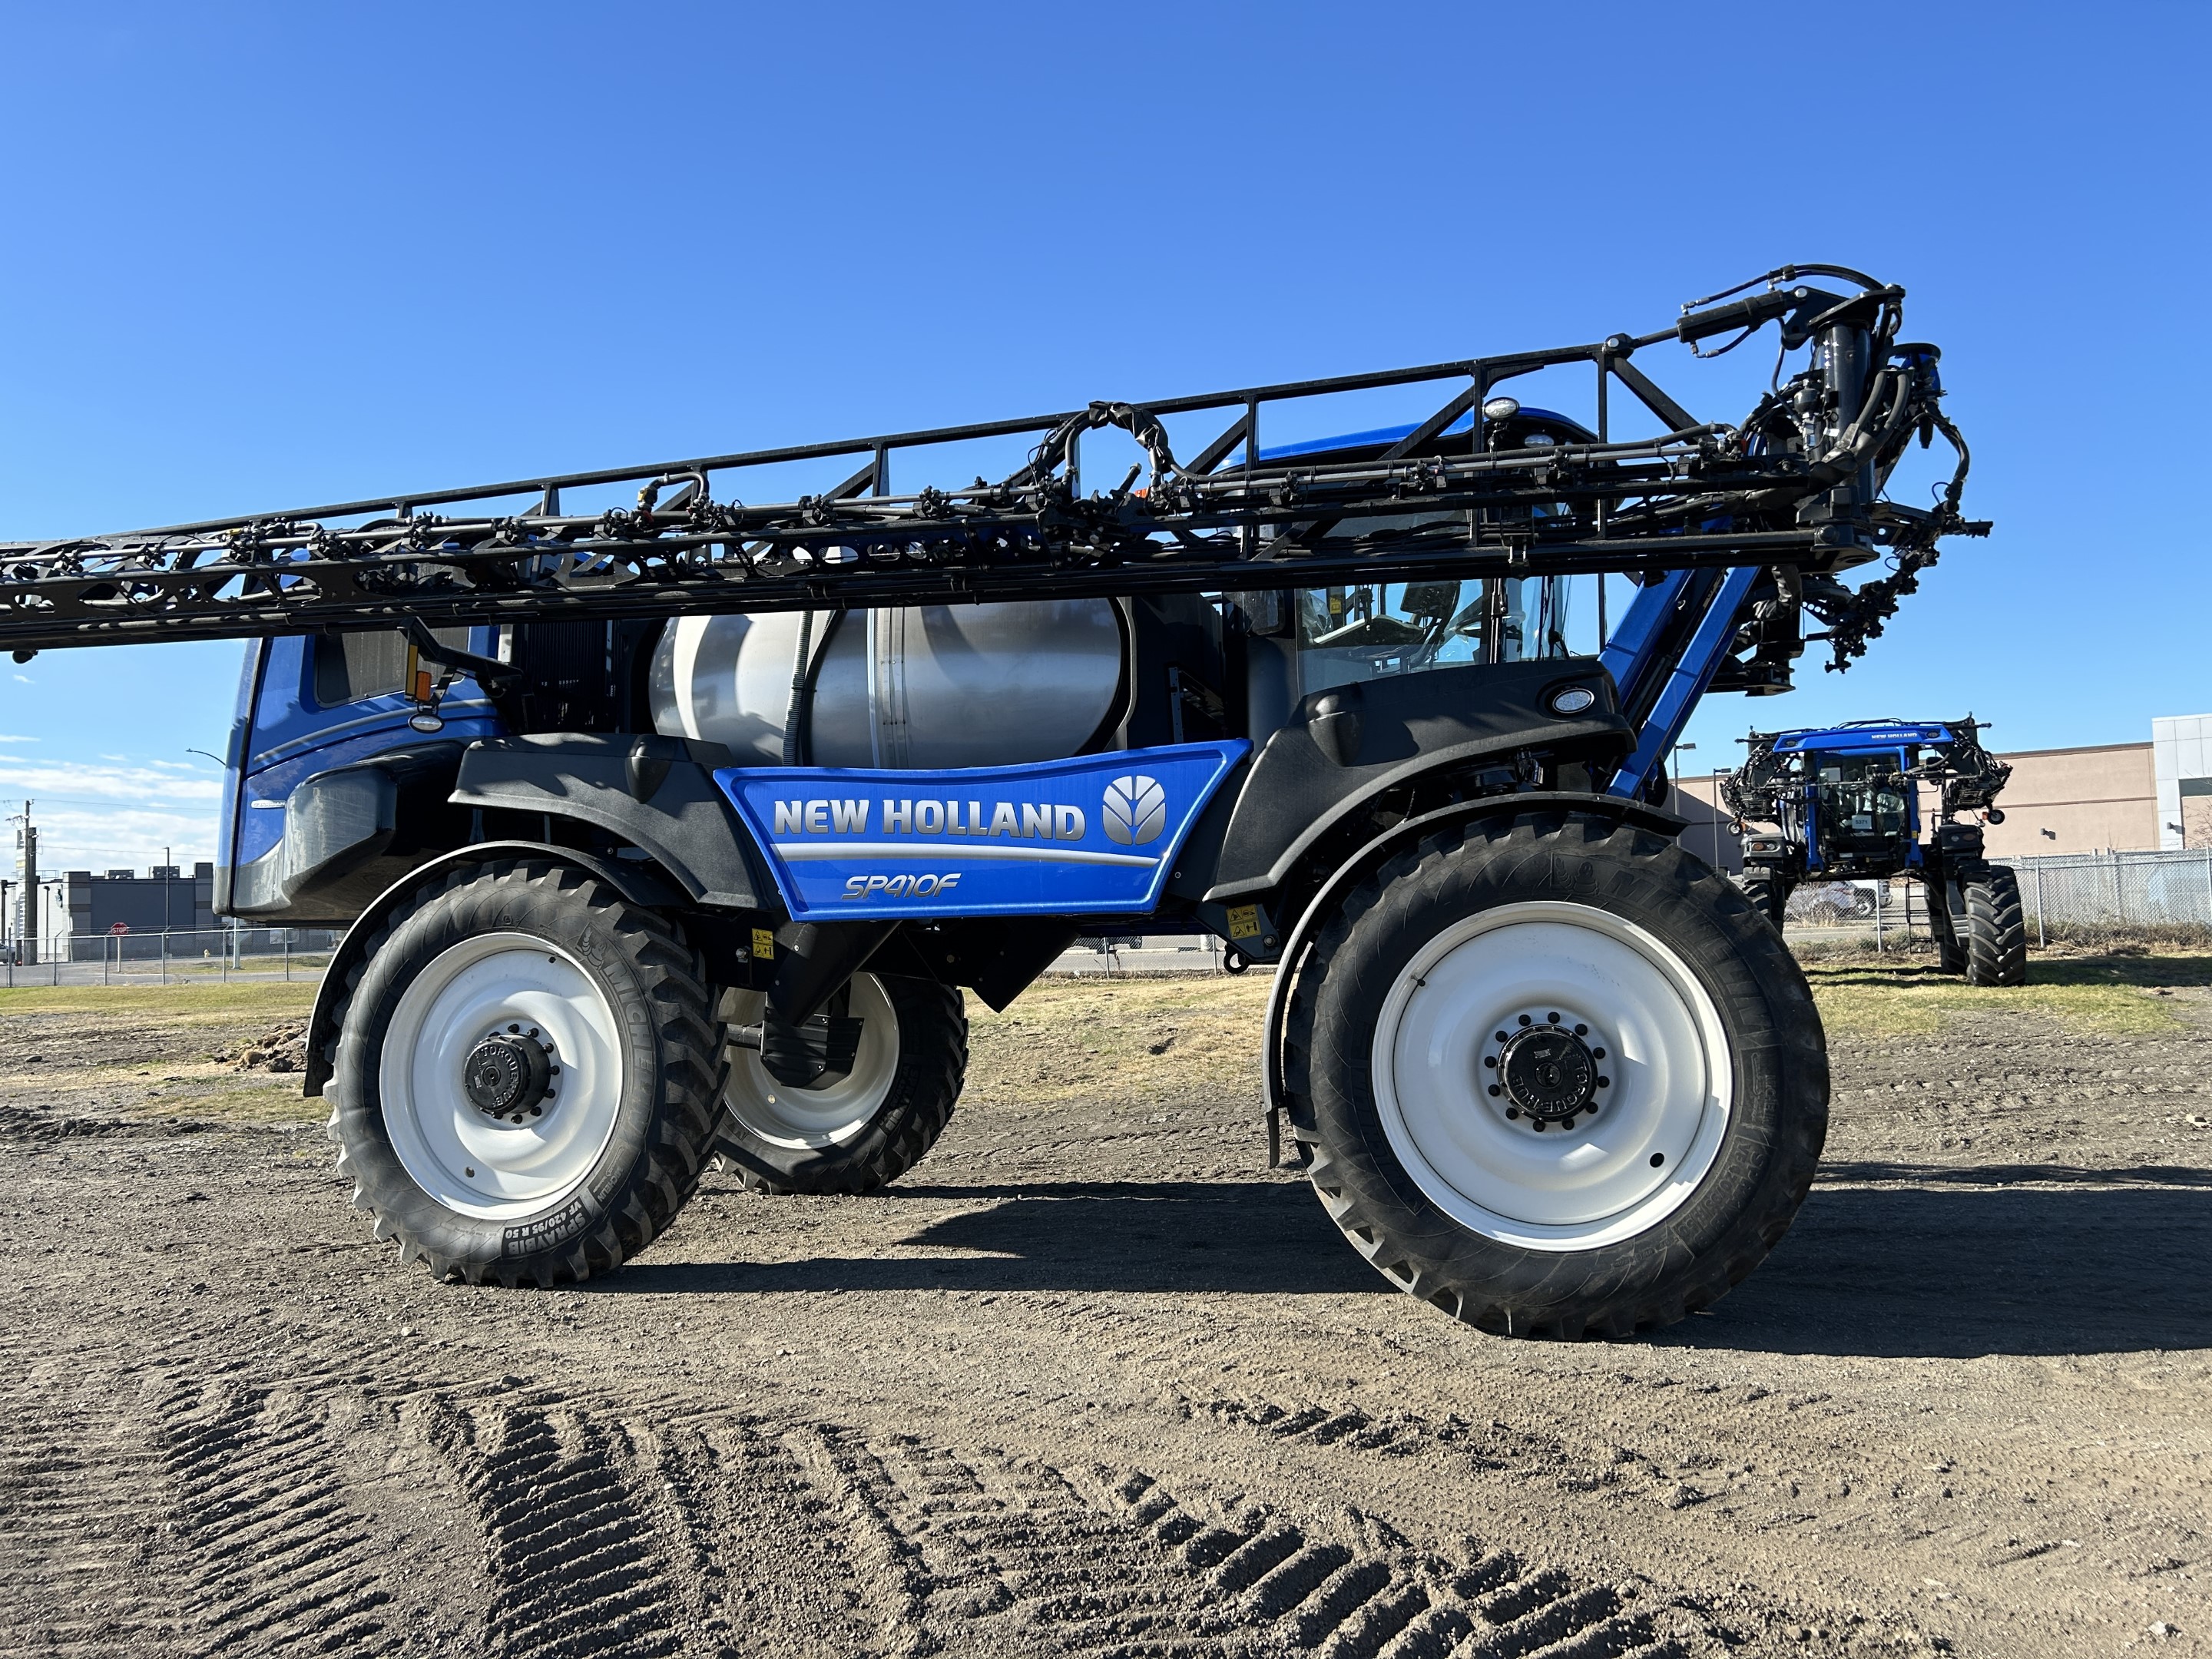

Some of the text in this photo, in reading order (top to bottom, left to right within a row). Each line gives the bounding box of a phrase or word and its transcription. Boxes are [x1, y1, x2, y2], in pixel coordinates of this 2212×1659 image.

[774, 800, 1086, 841] NEW HOLLAND
[842, 873, 962, 899] SP410F
[604, 961, 654, 1132] MICHELIN
[596, 1165, 624, 1203] MICHELIN
[568, 1200, 582, 1216] VF
[505, 1229, 519, 1239] 50
[508, 1212, 586, 1255] SPRAYBIB
[522, 1227, 529, 1237] R
[532, 1212, 567, 1234] 420/95
